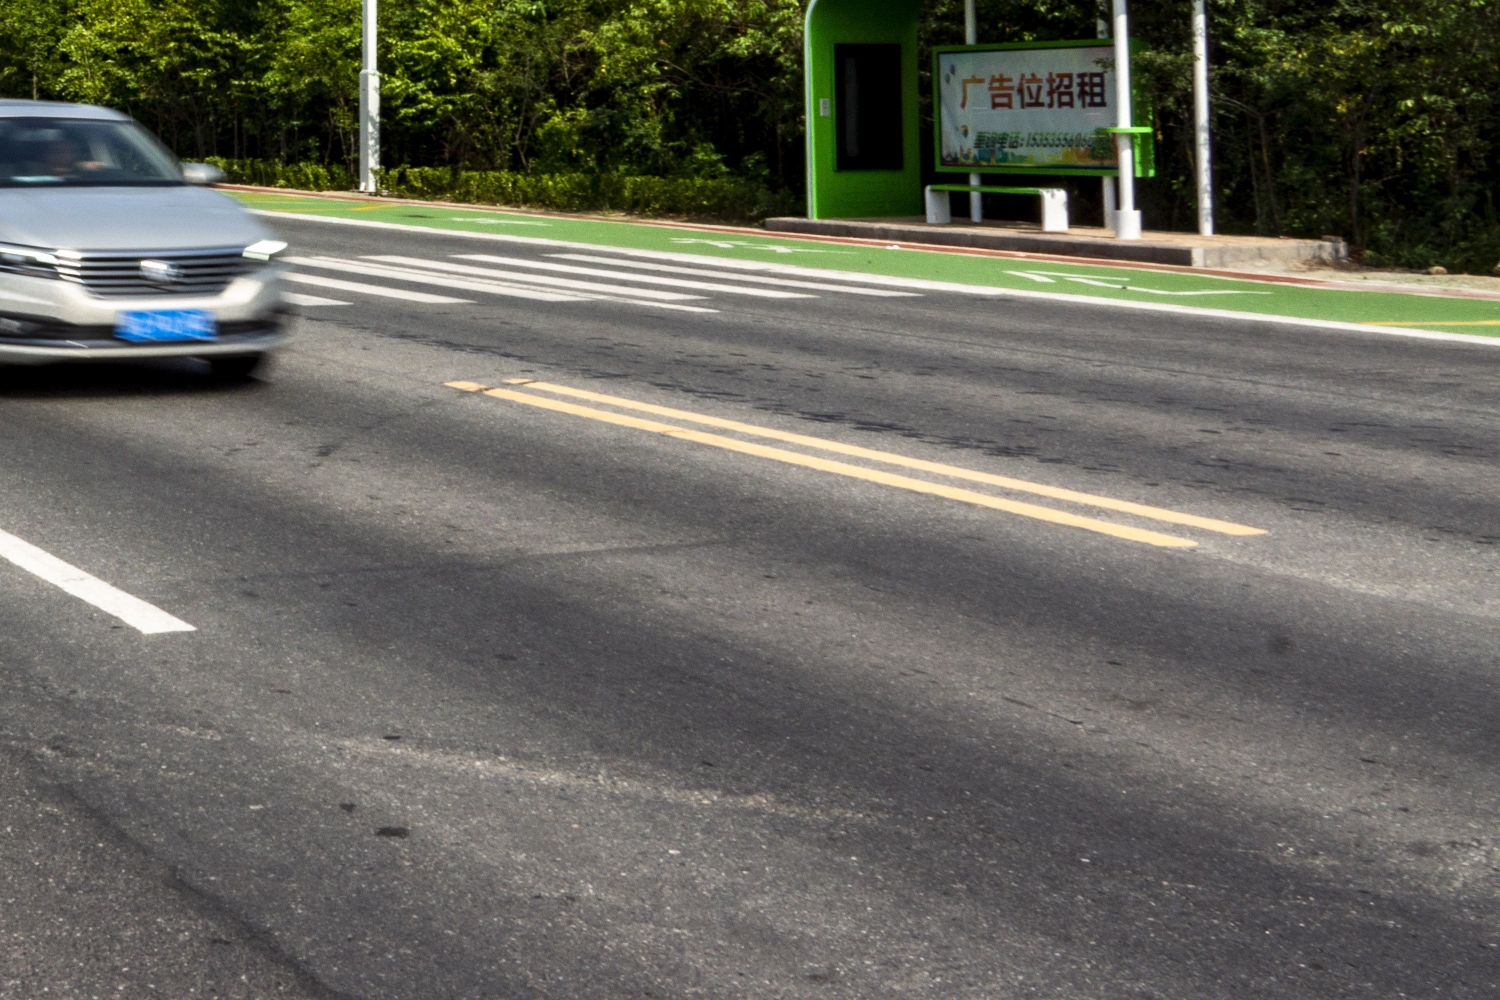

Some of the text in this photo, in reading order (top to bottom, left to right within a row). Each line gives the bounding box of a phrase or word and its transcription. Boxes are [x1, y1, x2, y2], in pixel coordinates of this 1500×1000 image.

[959, 71, 1108, 110] 广告位招租
